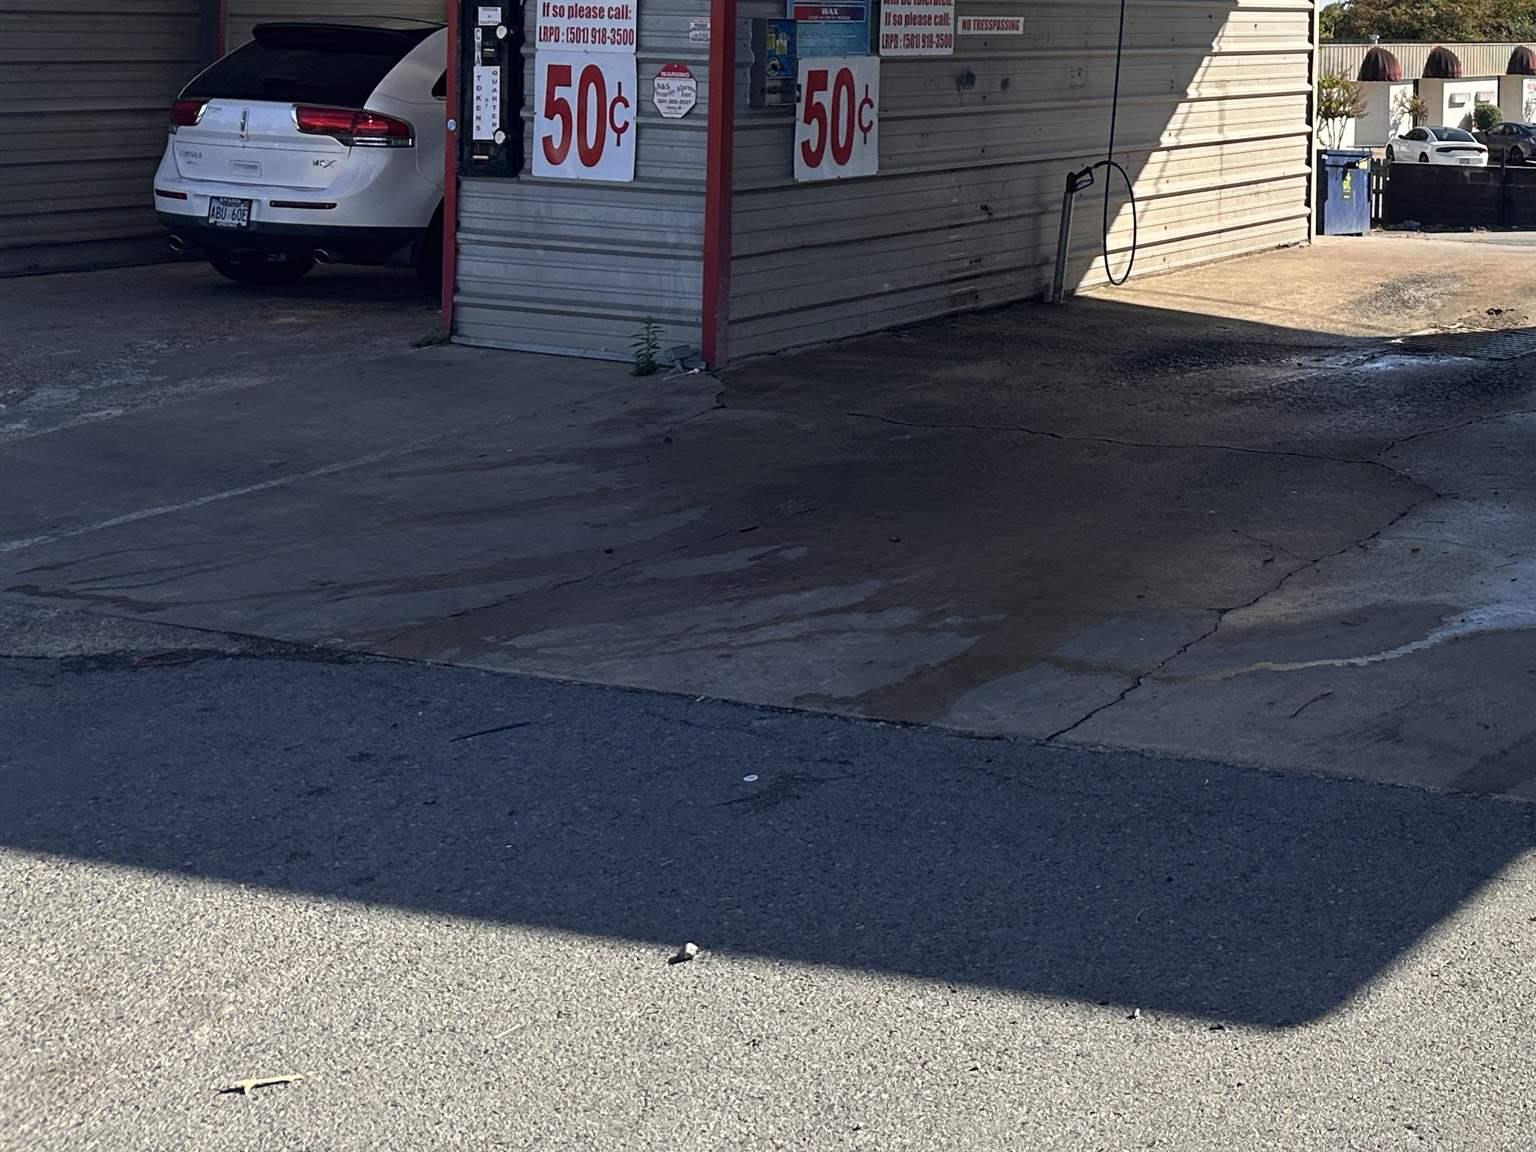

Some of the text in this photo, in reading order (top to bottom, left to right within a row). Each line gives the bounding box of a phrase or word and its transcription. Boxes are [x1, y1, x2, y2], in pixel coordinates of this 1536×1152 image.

[542, 1, 632, 20] If so please call:
[821, 7, 839, 16] WAX
[885, 12, 951, 27] If so please call:
[961, 19, 972, 31] NO
[539, 26, 560, 43] LRPD
[566, 27, 589, 44] (501)
[591, 27, 635, 46] 918-3500
[921, 34, 953, 49] 918-3500
[542, 64, 630, 168] 50¢
[801, 67, 875, 169] 50¢
[211, 206, 227, 221] ABU
